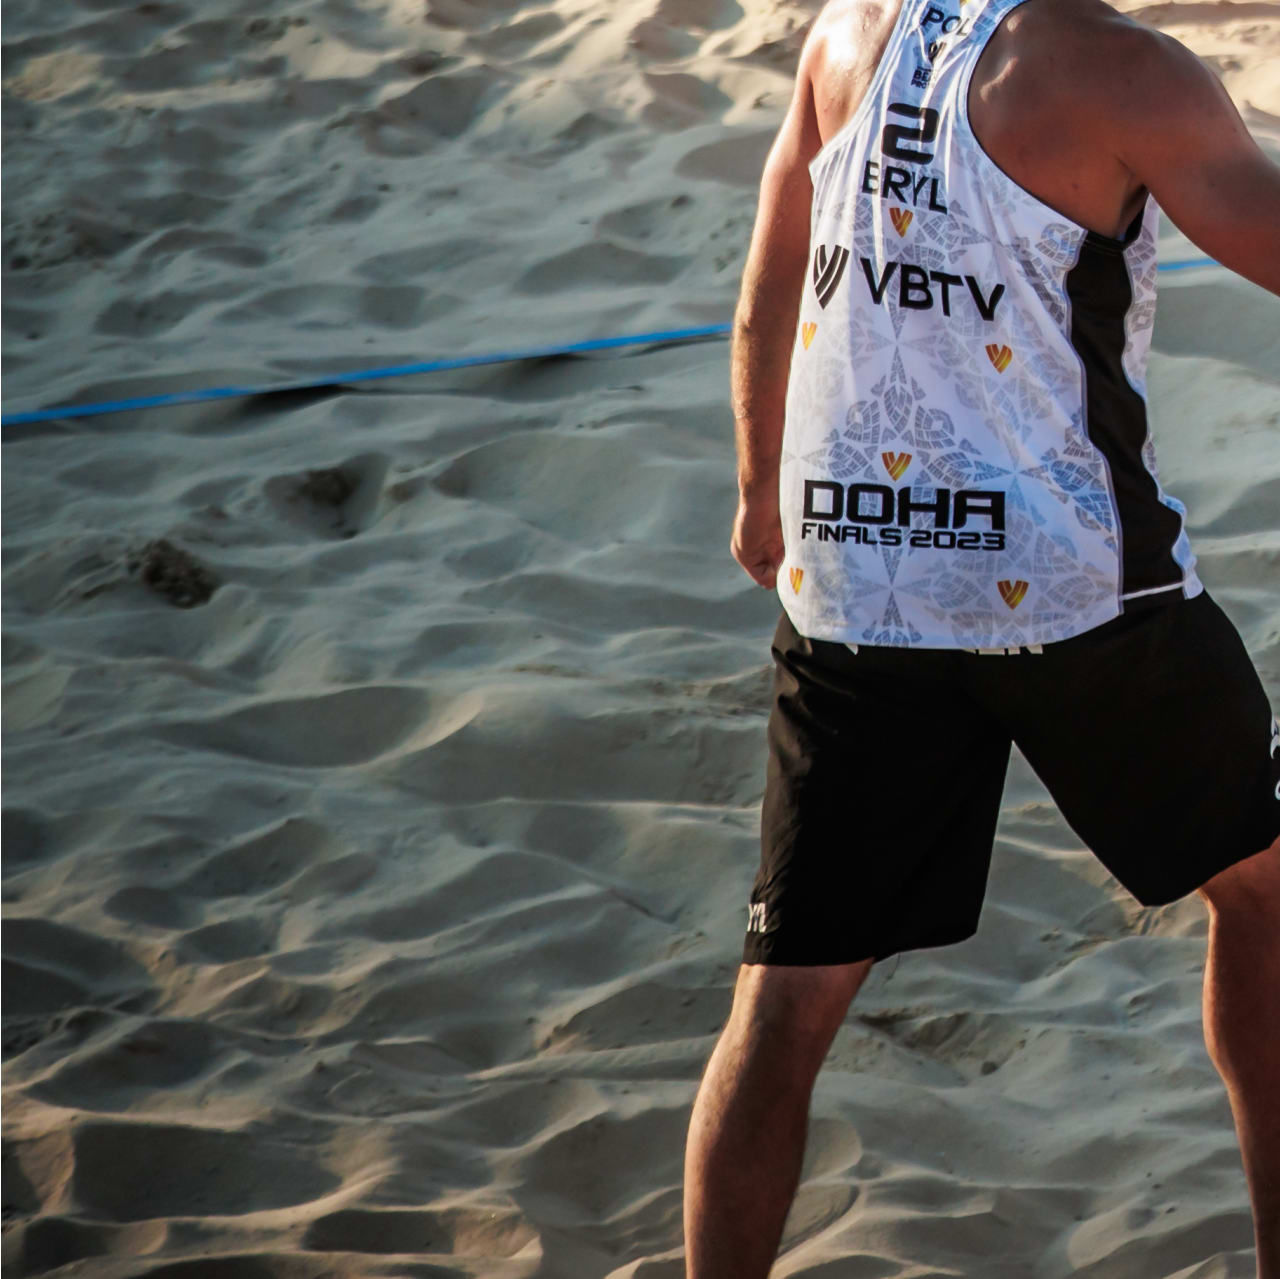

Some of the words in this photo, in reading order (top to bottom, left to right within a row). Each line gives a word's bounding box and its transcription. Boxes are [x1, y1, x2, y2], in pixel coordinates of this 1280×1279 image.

[920, 6, 971, 37] POL
[881, 102, 940, 166] 2
[859, 256, 1006, 322] VBTV
[802, 479, 1007, 532] DOHA
[801, 522, 903, 548] FINALS
[909, 529, 1007, 552] 2023
